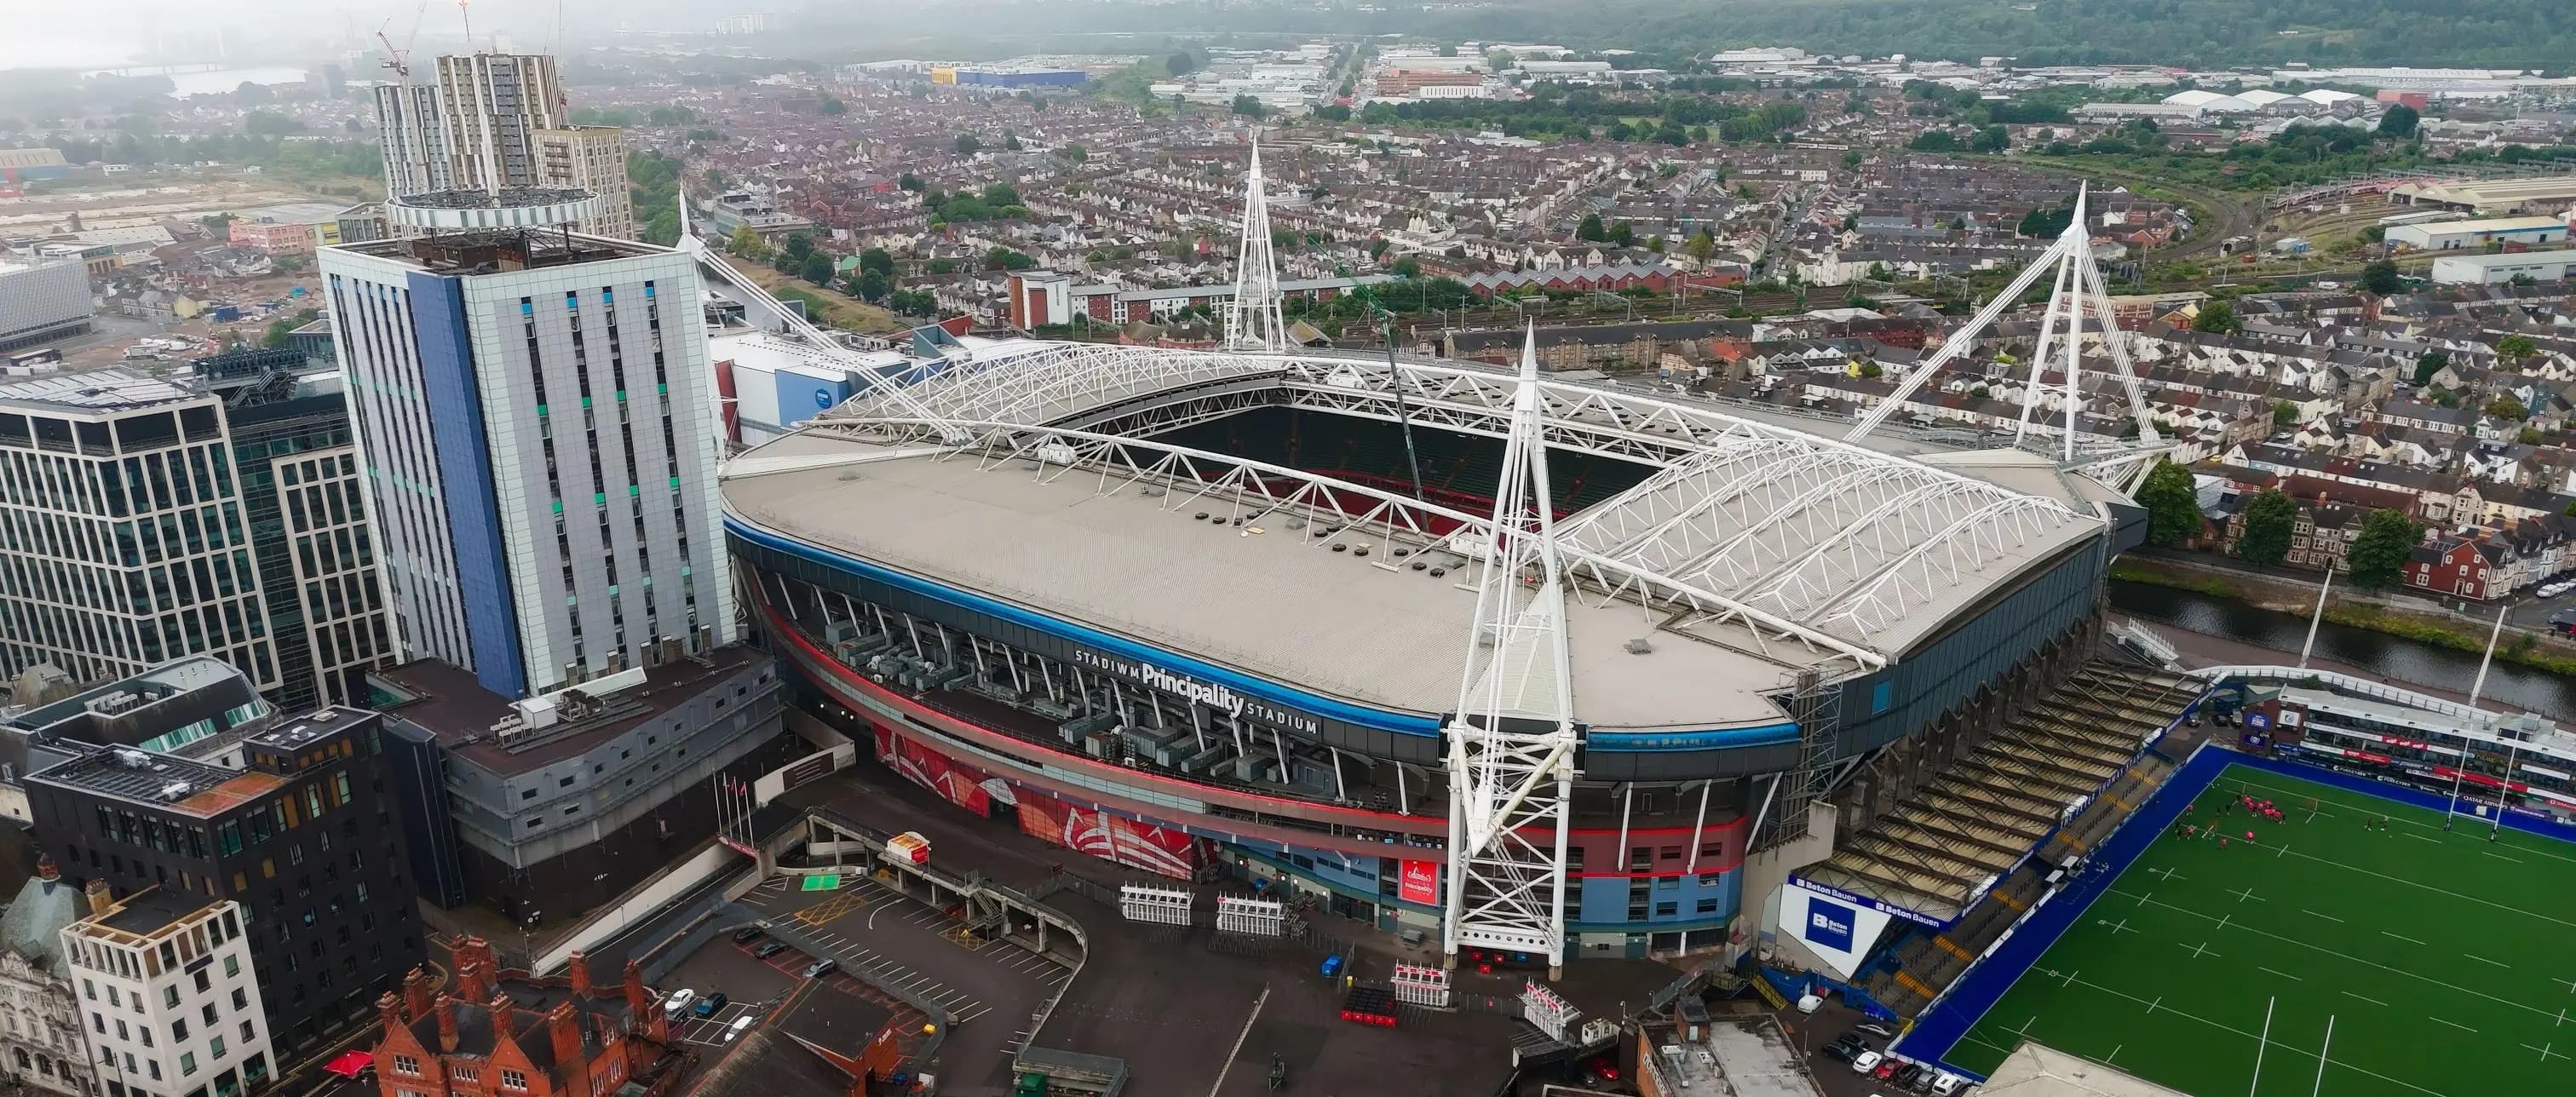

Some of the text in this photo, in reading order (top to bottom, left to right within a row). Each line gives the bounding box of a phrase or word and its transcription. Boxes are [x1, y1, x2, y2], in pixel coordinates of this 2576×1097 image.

[1075, 650, 1317, 734] STADIWM Principality STADIUM
[2463, 795, 2482, 804] QATAR
[1805, 879, 1857, 903] Beton Bauen
[1885, 905, 1940, 928] Beton Bauen
